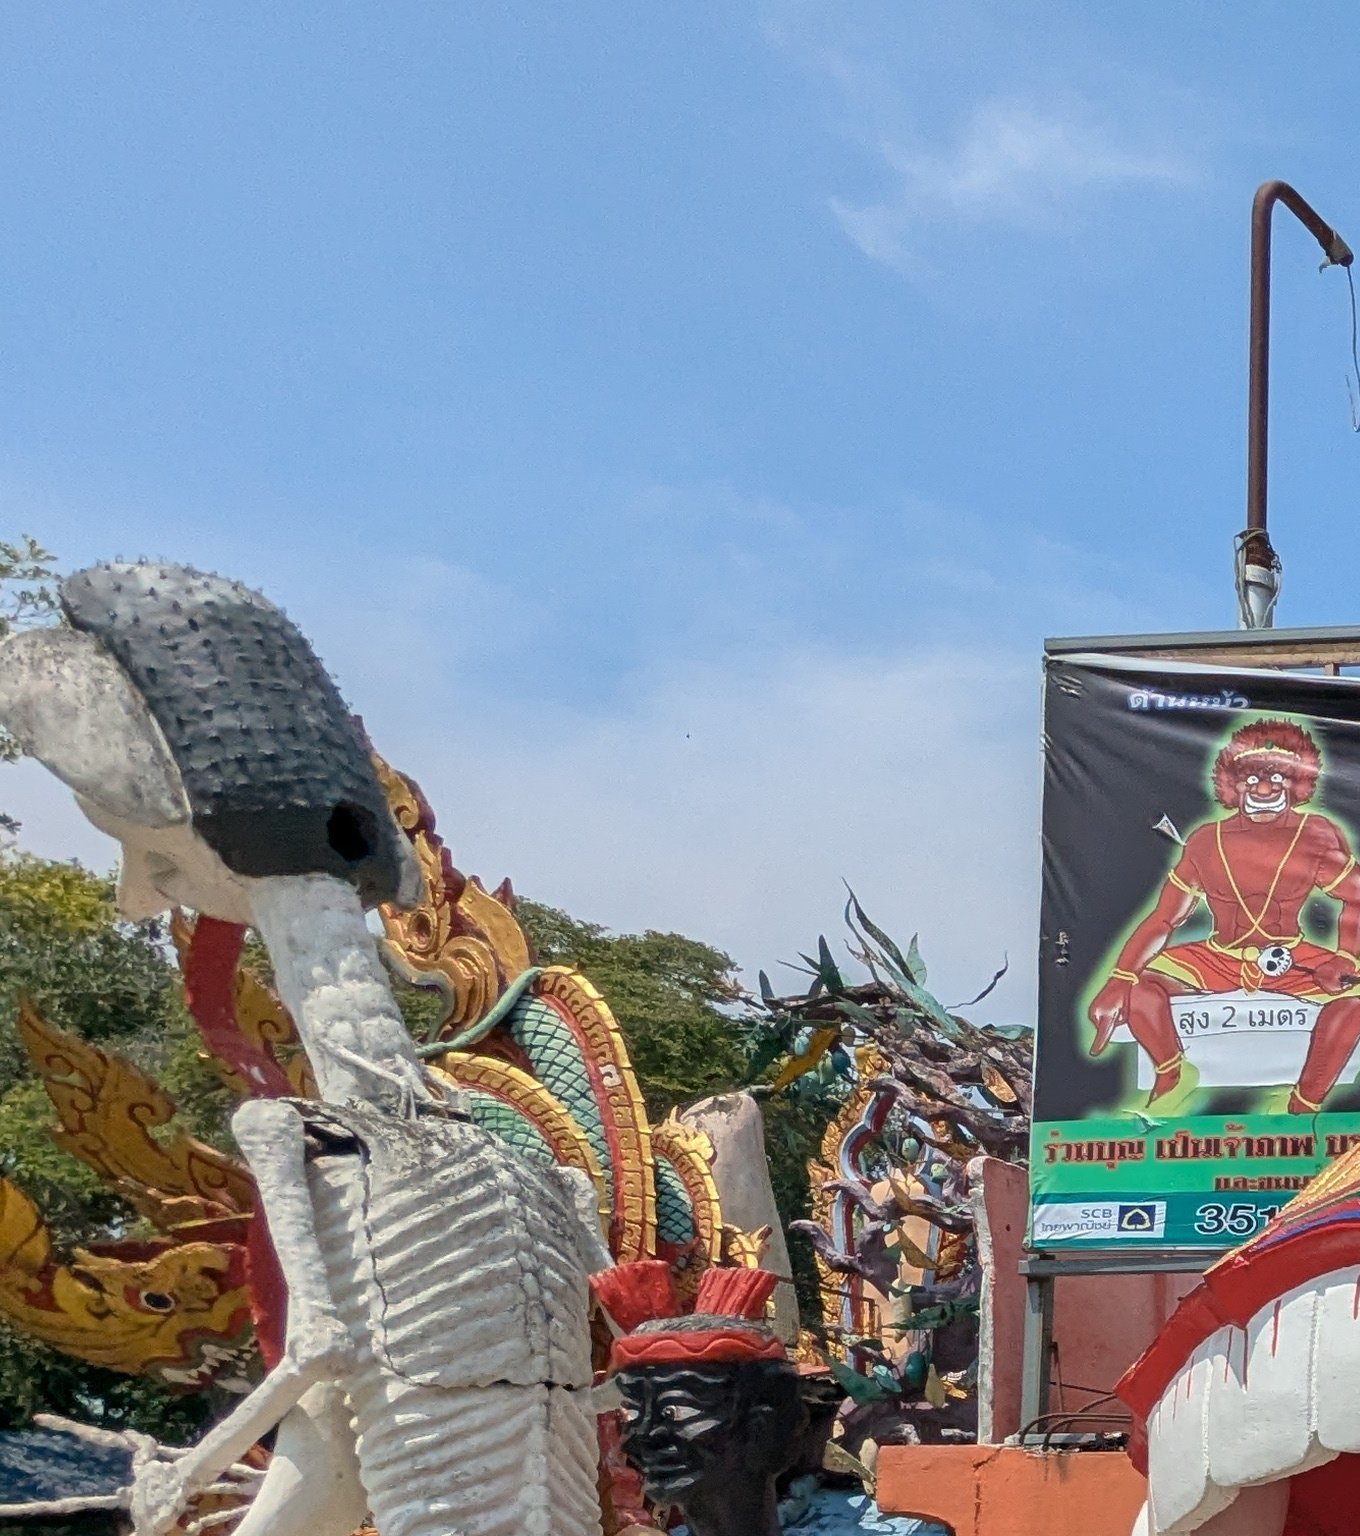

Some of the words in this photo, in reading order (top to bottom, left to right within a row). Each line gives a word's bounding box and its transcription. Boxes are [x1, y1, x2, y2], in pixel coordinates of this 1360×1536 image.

[1179, 1010, 1210, 1035] สูง
[1221, 1005, 1237, 1028] 2
[1248, 1008, 1308, 1027] เมตร
[1044, 1131, 1145, 1170] ร่วมบุญ
[1155, 1123, 1315, 1161] เป็นเจ้าภาพ
[1080, 1208, 1113, 1219] SCB
[1041, 1219, 1112, 1232] ไทยพาณิชย์
